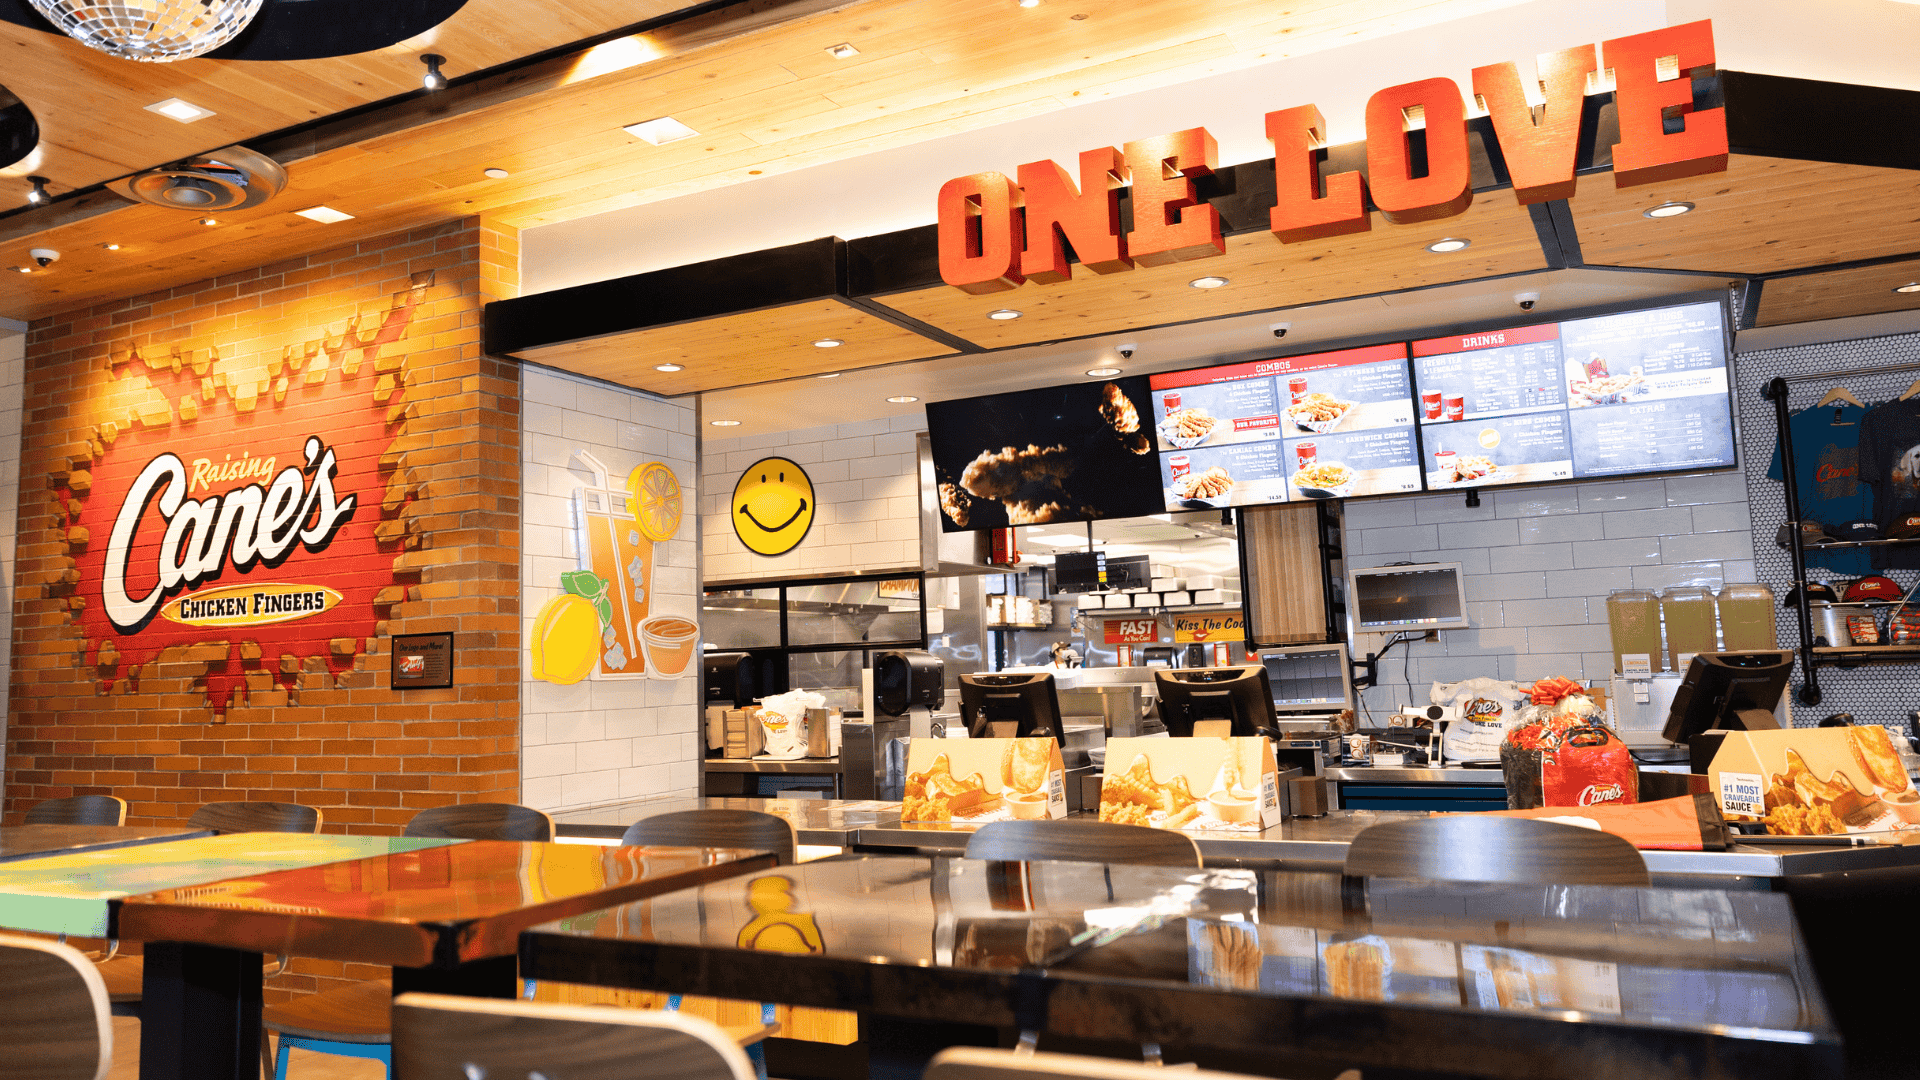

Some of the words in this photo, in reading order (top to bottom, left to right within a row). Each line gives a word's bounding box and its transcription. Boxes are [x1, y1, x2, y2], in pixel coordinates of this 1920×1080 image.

[938, 127, 1226, 295] ONE
[1265, 19, 1728, 243] LOVE
[1462, 333, 1505, 348] DRINKS
[1447, 356, 1462, 364] TEA
[1255, 361, 1291, 373] COMBOS
[1377, 364, 1401, 373] COMBO
[1247, 380, 1269, 389] COMBO
[1629, 403, 1666, 415] EXTRAS
[1534, 415, 1561, 424] COMBO
[1384, 431, 1409, 440] COMBO
[189, 451, 276, 493] Raising
[102, 435, 357, 636] Cane's
[180, 595, 247, 619] CHICKEN
[253, 591, 325, 614] FINGERS
[1119, 620, 1154, 635] FAST
[1176, 618, 1199, 631] Kiss
[1202, 618, 1221, 630] The
[1579, 783, 1624, 807] Cane's
[1724, 784, 1733, 793] #1
[1736, 784, 1759, 795] MOST
[1724, 793, 1760, 804] CRAVEABLE
[1725, 801, 1752, 812] SAUCE
